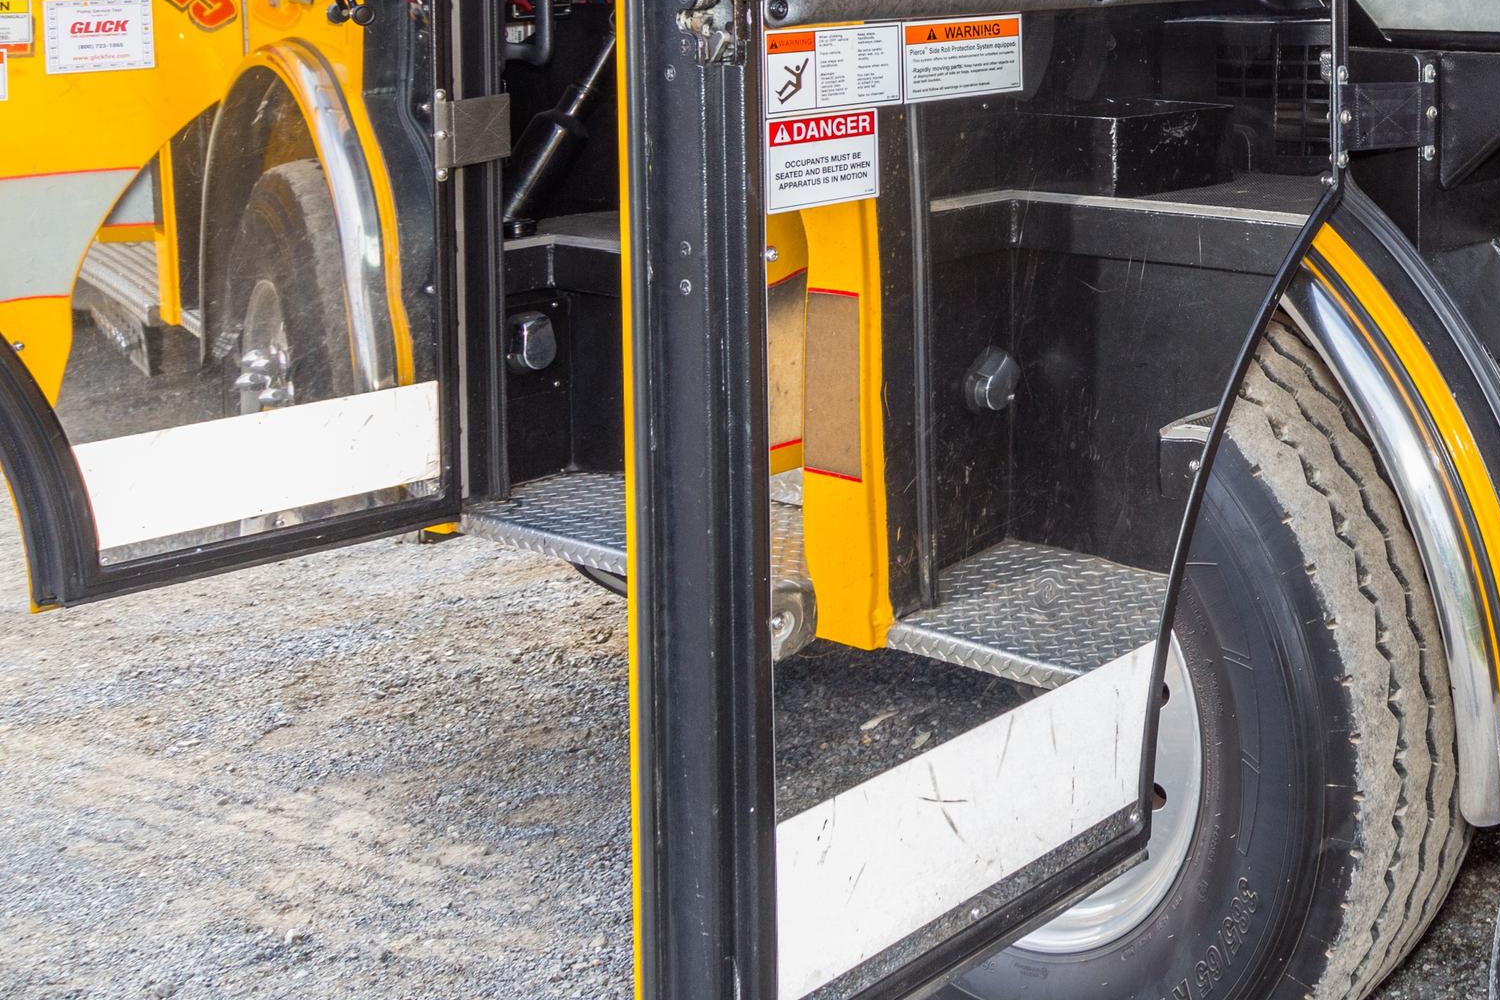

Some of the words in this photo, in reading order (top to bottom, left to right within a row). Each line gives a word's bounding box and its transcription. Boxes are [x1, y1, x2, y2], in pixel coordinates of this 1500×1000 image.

[70, 19, 130, 35] GLICK
[944, 23, 1001, 40] WARNING
[779, 38, 812, 47] WARNING
[928, 46, 940, 55] Side
[941, 45, 950, 54] Roll
[951, 43, 976, 53] Protection
[976, 41, 993, 51] System
[932, 65, 950, 73] moving
[793, 115, 871, 142] DANGER
[785, 156, 829, 169] OCCUPANTS
[831, 153, 851, 163] MUST
[852, 151, 862, 159] BE
[775, 170, 804, 181] SEATED
[805, 167, 820, 177] AND
[822, 163, 849, 174] BELTED
[850, 160, 871, 170] WHEN
[779, 178, 821, 191] APPARATUS
[823, 176, 830, 184] IS
[831, 175, 839, 183] IN
[840, 171, 868, 181] MOTION
